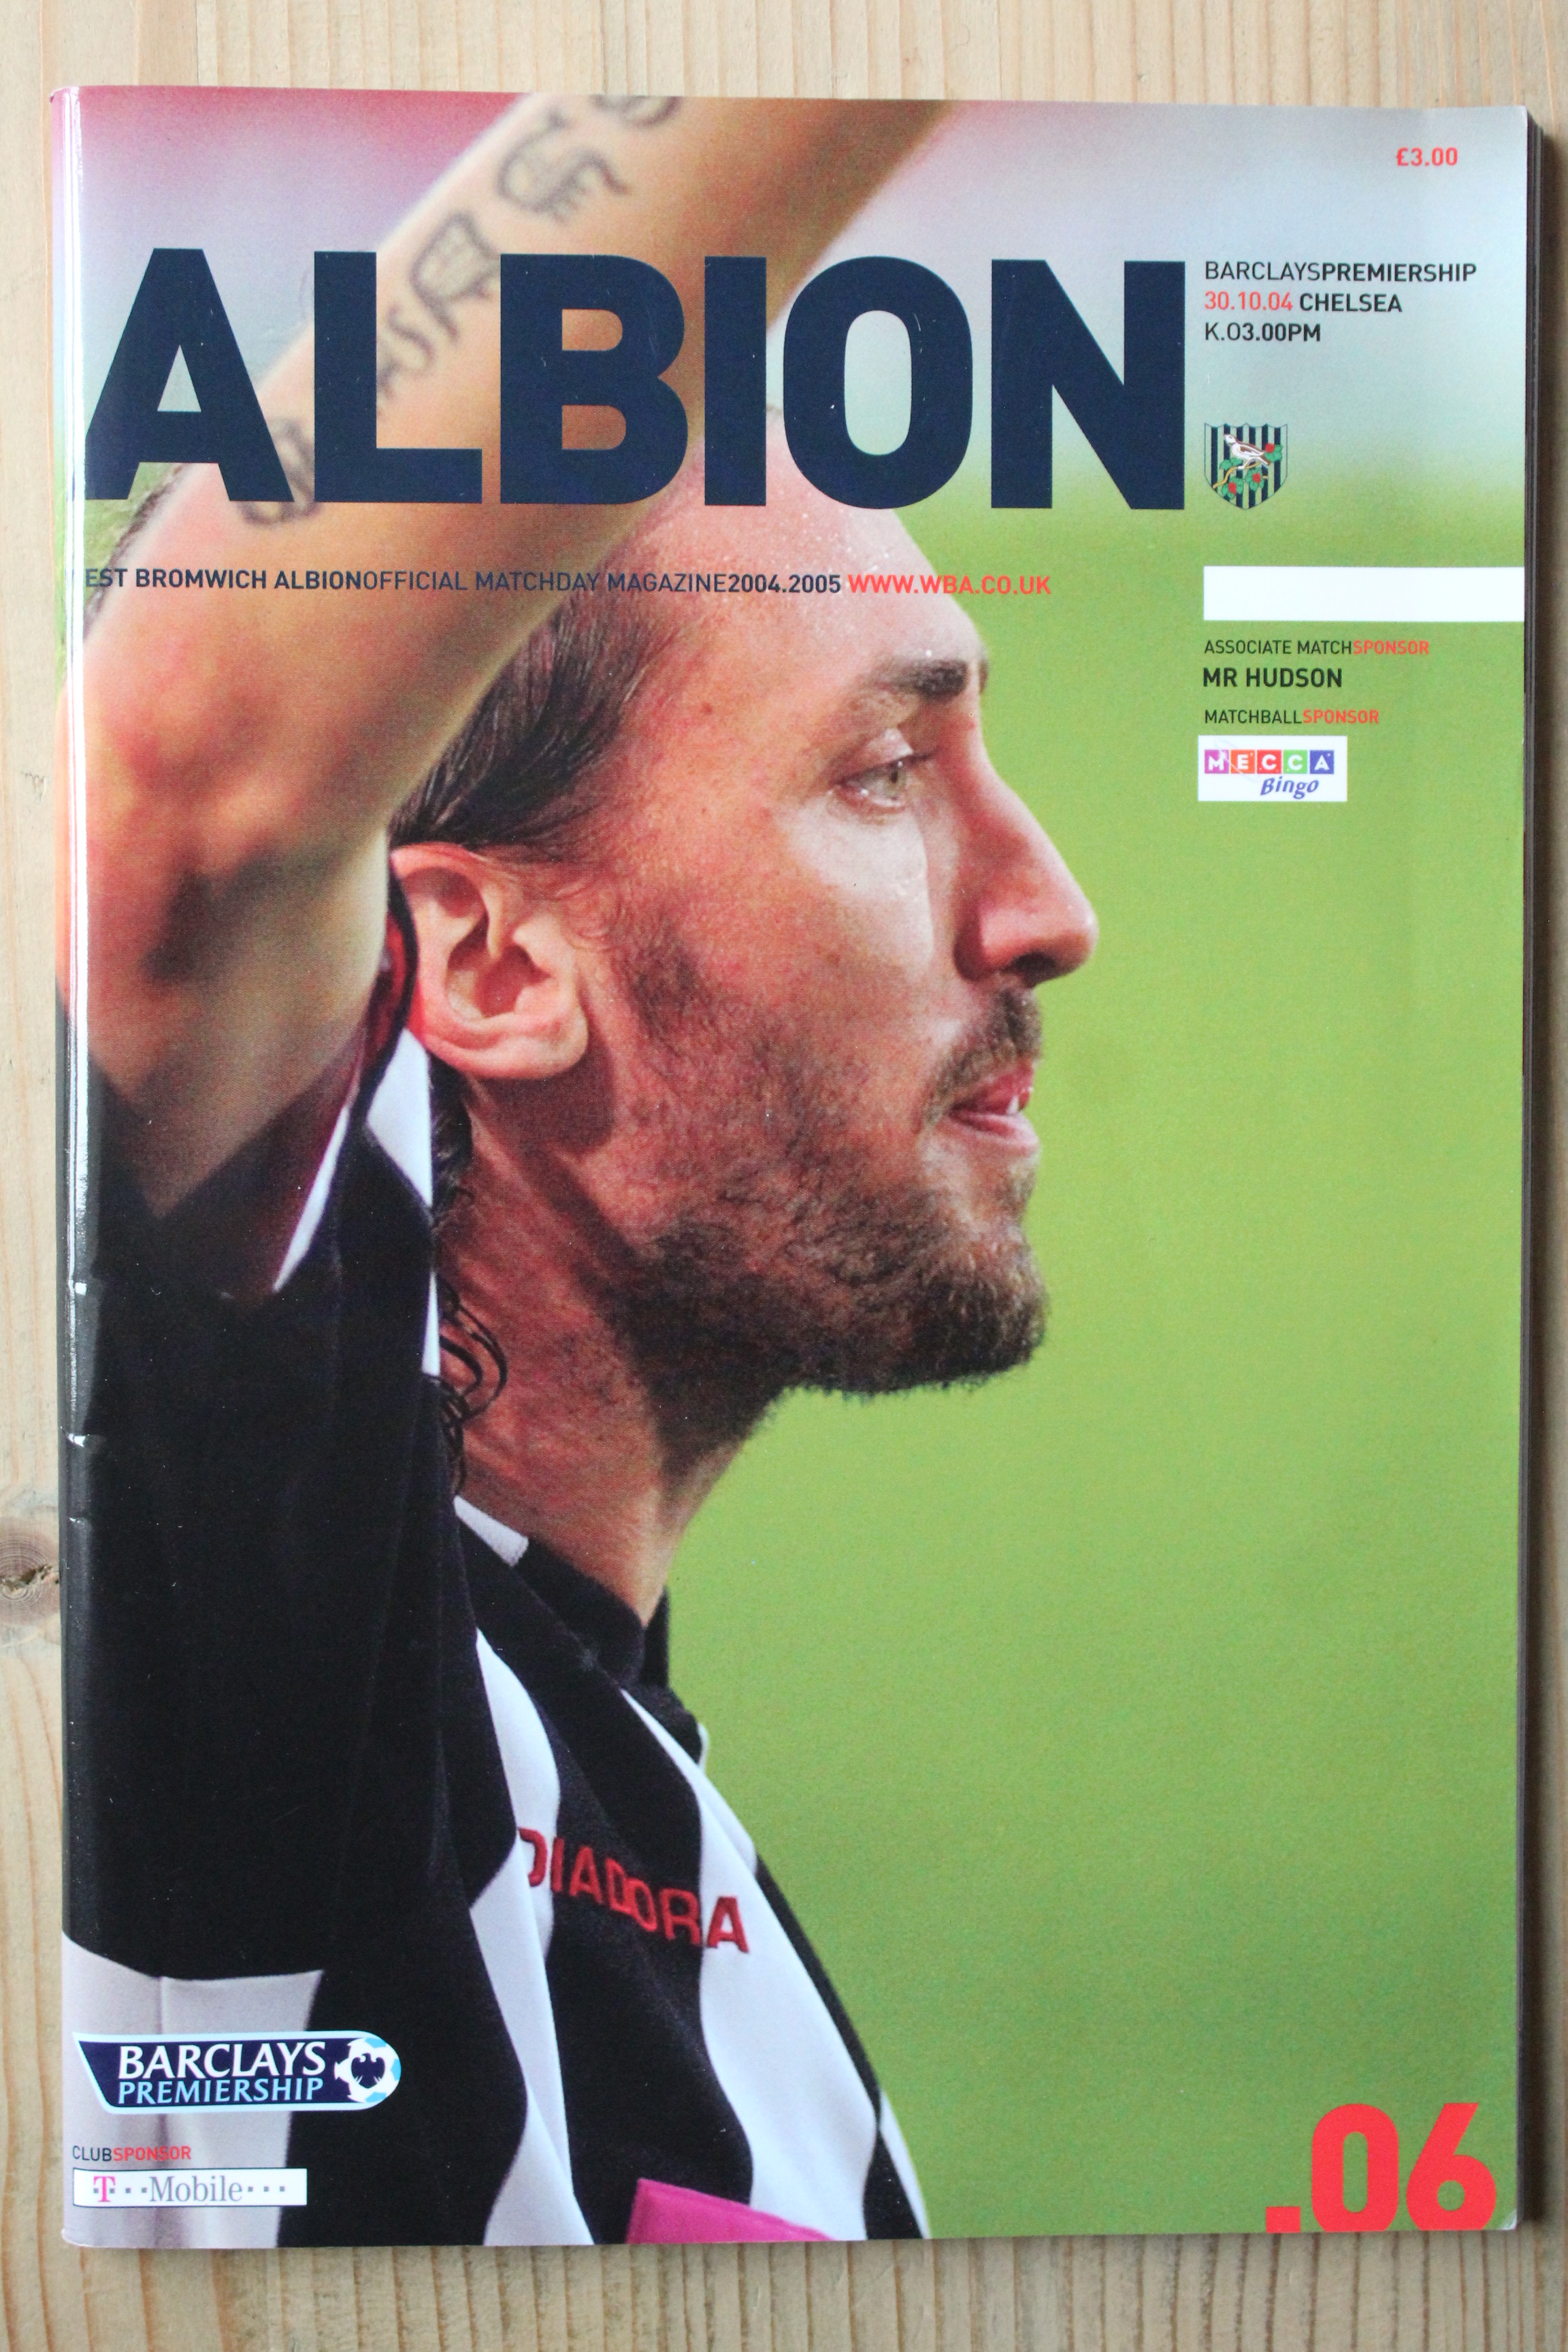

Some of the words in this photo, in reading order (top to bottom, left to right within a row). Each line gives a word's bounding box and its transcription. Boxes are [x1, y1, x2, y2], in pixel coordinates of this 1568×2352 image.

[1396, 147, 1458, 167] £3.00
[1205, 291, 1293, 311] 30.10.04
[1299, 293, 1403, 313] CHELSEA
[85, 248, 1186, 510] ALBION
[65, 568, 128, 588] EST
[136, 568, 267, 589] BROMWICH
[476, 572, 598, 591] MATCHDAY
[848, 574, 1052, 595] WWW.WBA.CO.UK
[1205, 640, 1292, 655] ASSOCIATE
[1203, 668, 1237, 687] MR
[1246, 668, 1342, 687] HUDSON
[1207, 751, 1332, 772] MECCA
[1260, 776, 1319, 800] Bingo
[118, 2041, 326, 2079] BARCLAYS
[118, 2077, 324, 2104] PREMIERSHIP
